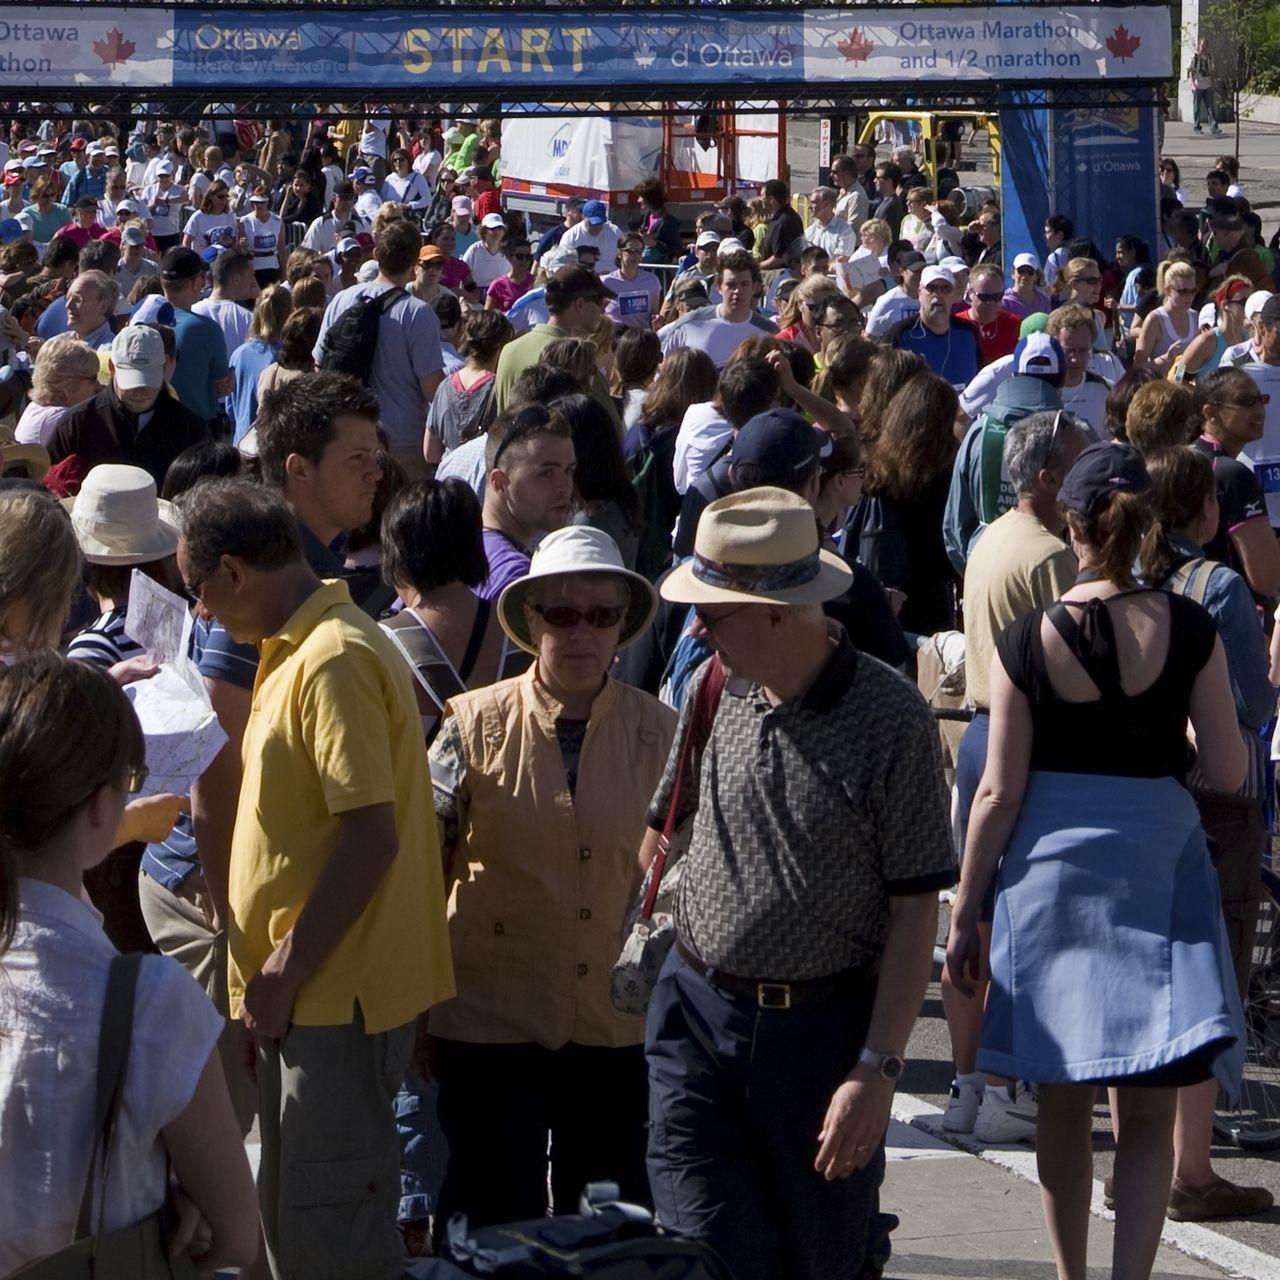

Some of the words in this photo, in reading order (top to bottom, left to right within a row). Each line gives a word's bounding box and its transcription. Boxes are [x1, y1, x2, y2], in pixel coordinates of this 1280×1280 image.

[195, 24, 302, 51] Ottawa
[899, 22, 975, 40] Ottawa
[982, 19, 1080, 39] Marathon
[402, 27, 592, 74] START
[671, 42, 793, 68] d'Ottawa
[899, 49, 938, 69] and
[945, 48, 979, 69] 1/2
[985, 48, 1081, 68] marathon
[194, 59, 243, 74] Race
[252, 57, 350, 75] Weekend
[1092, 160, 1142, 173] d'Ottawa
